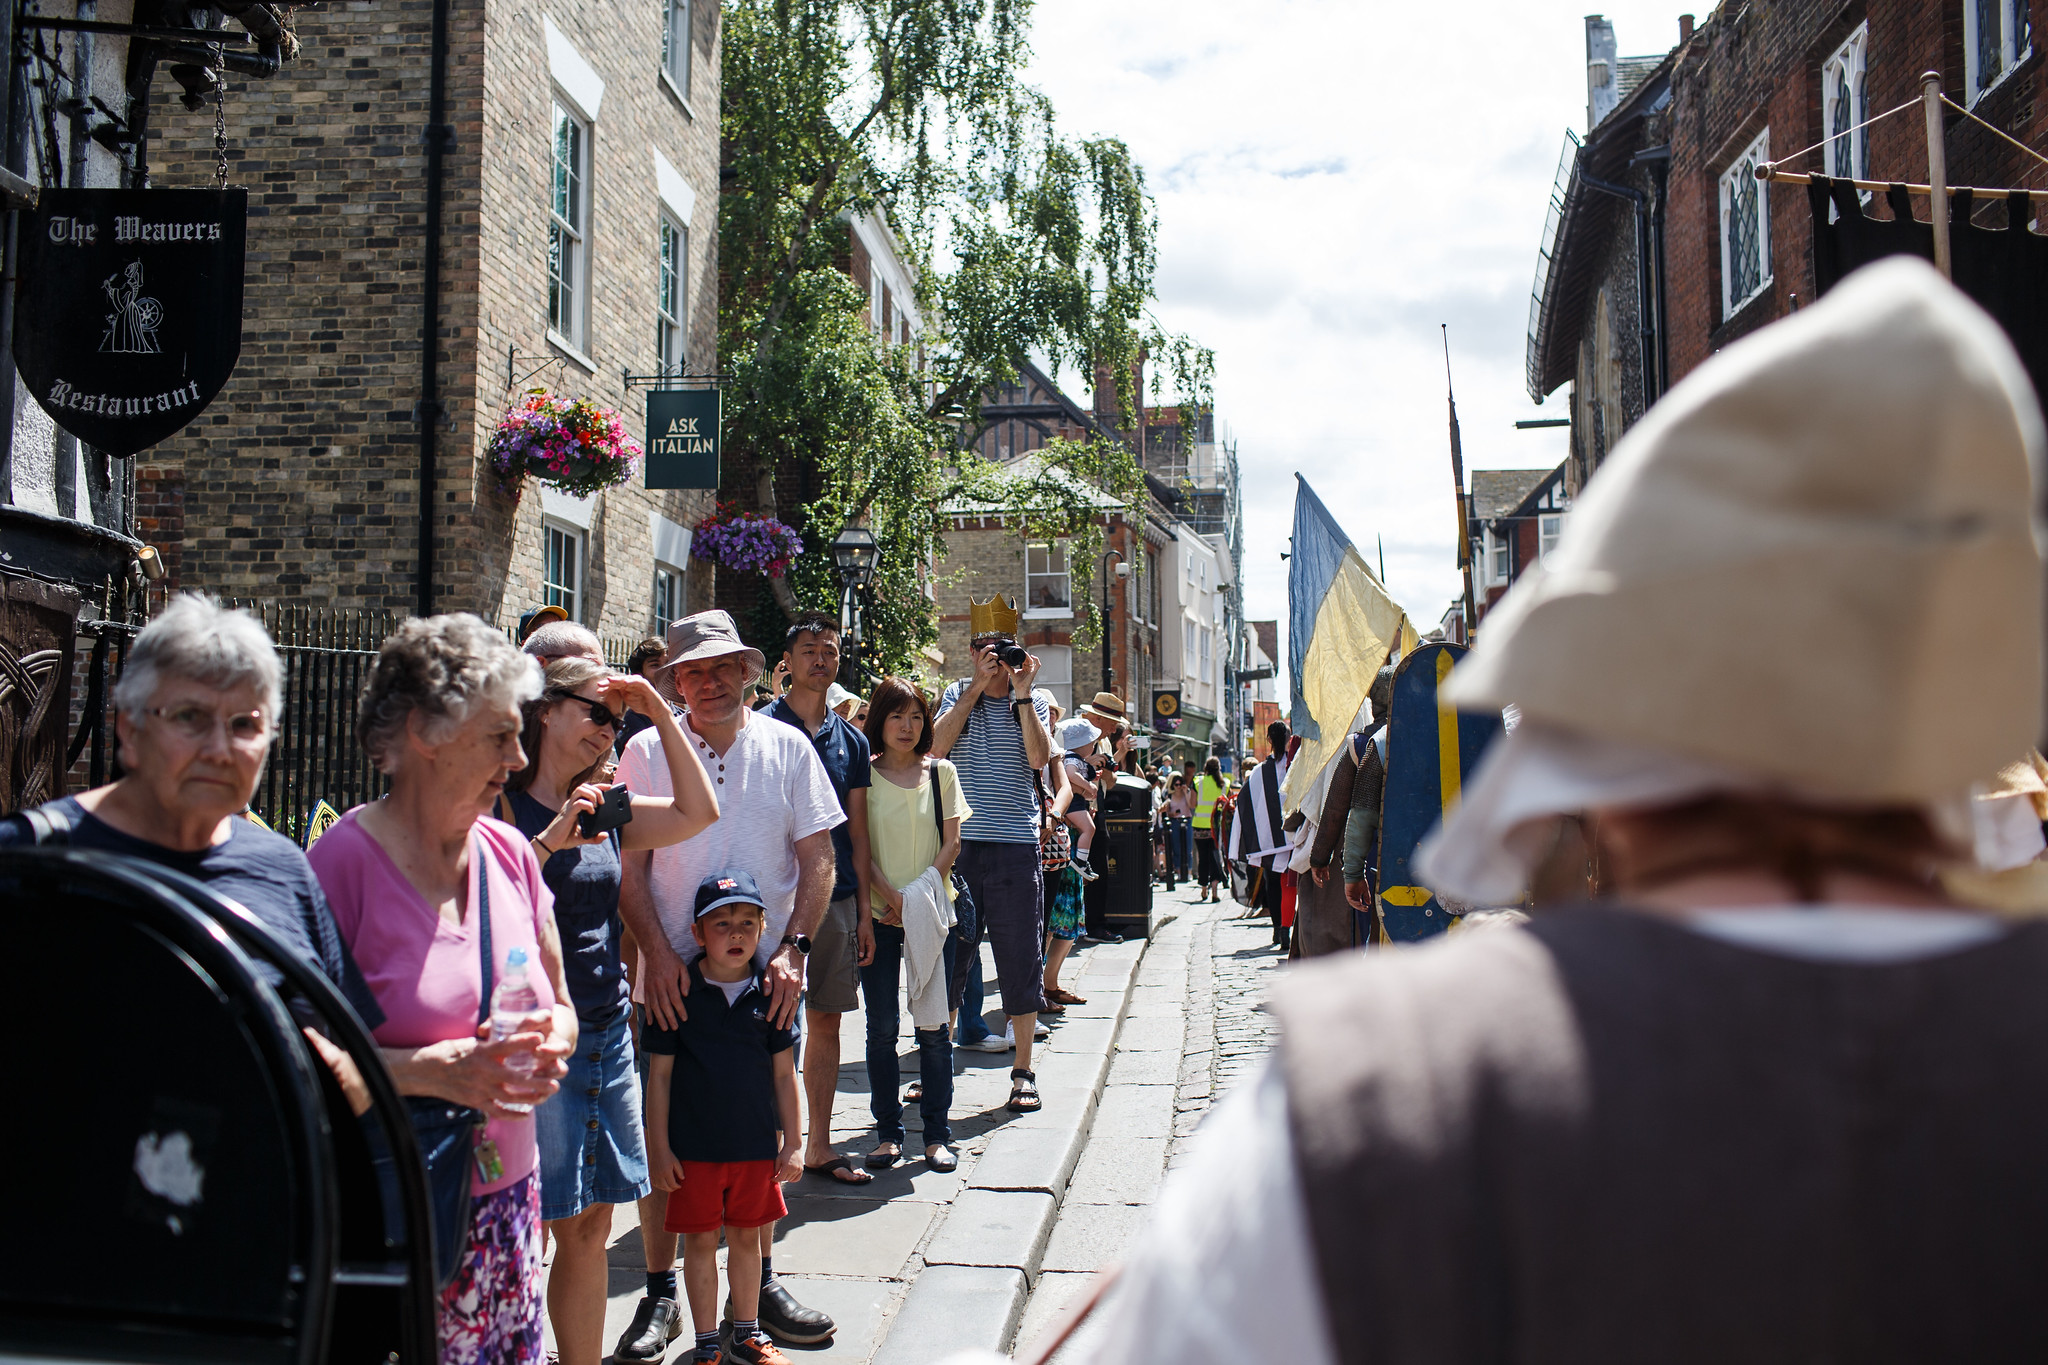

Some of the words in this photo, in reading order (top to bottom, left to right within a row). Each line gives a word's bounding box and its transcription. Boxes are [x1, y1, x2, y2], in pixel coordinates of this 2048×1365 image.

[49, 216, 98, 247] The
[114, 216, 222, 242] Weavers
[47, 378, 201, 416] Restaurant
[668, 417, 698, 433] ASK
[652, 438, 714, 454] ITALIAN
